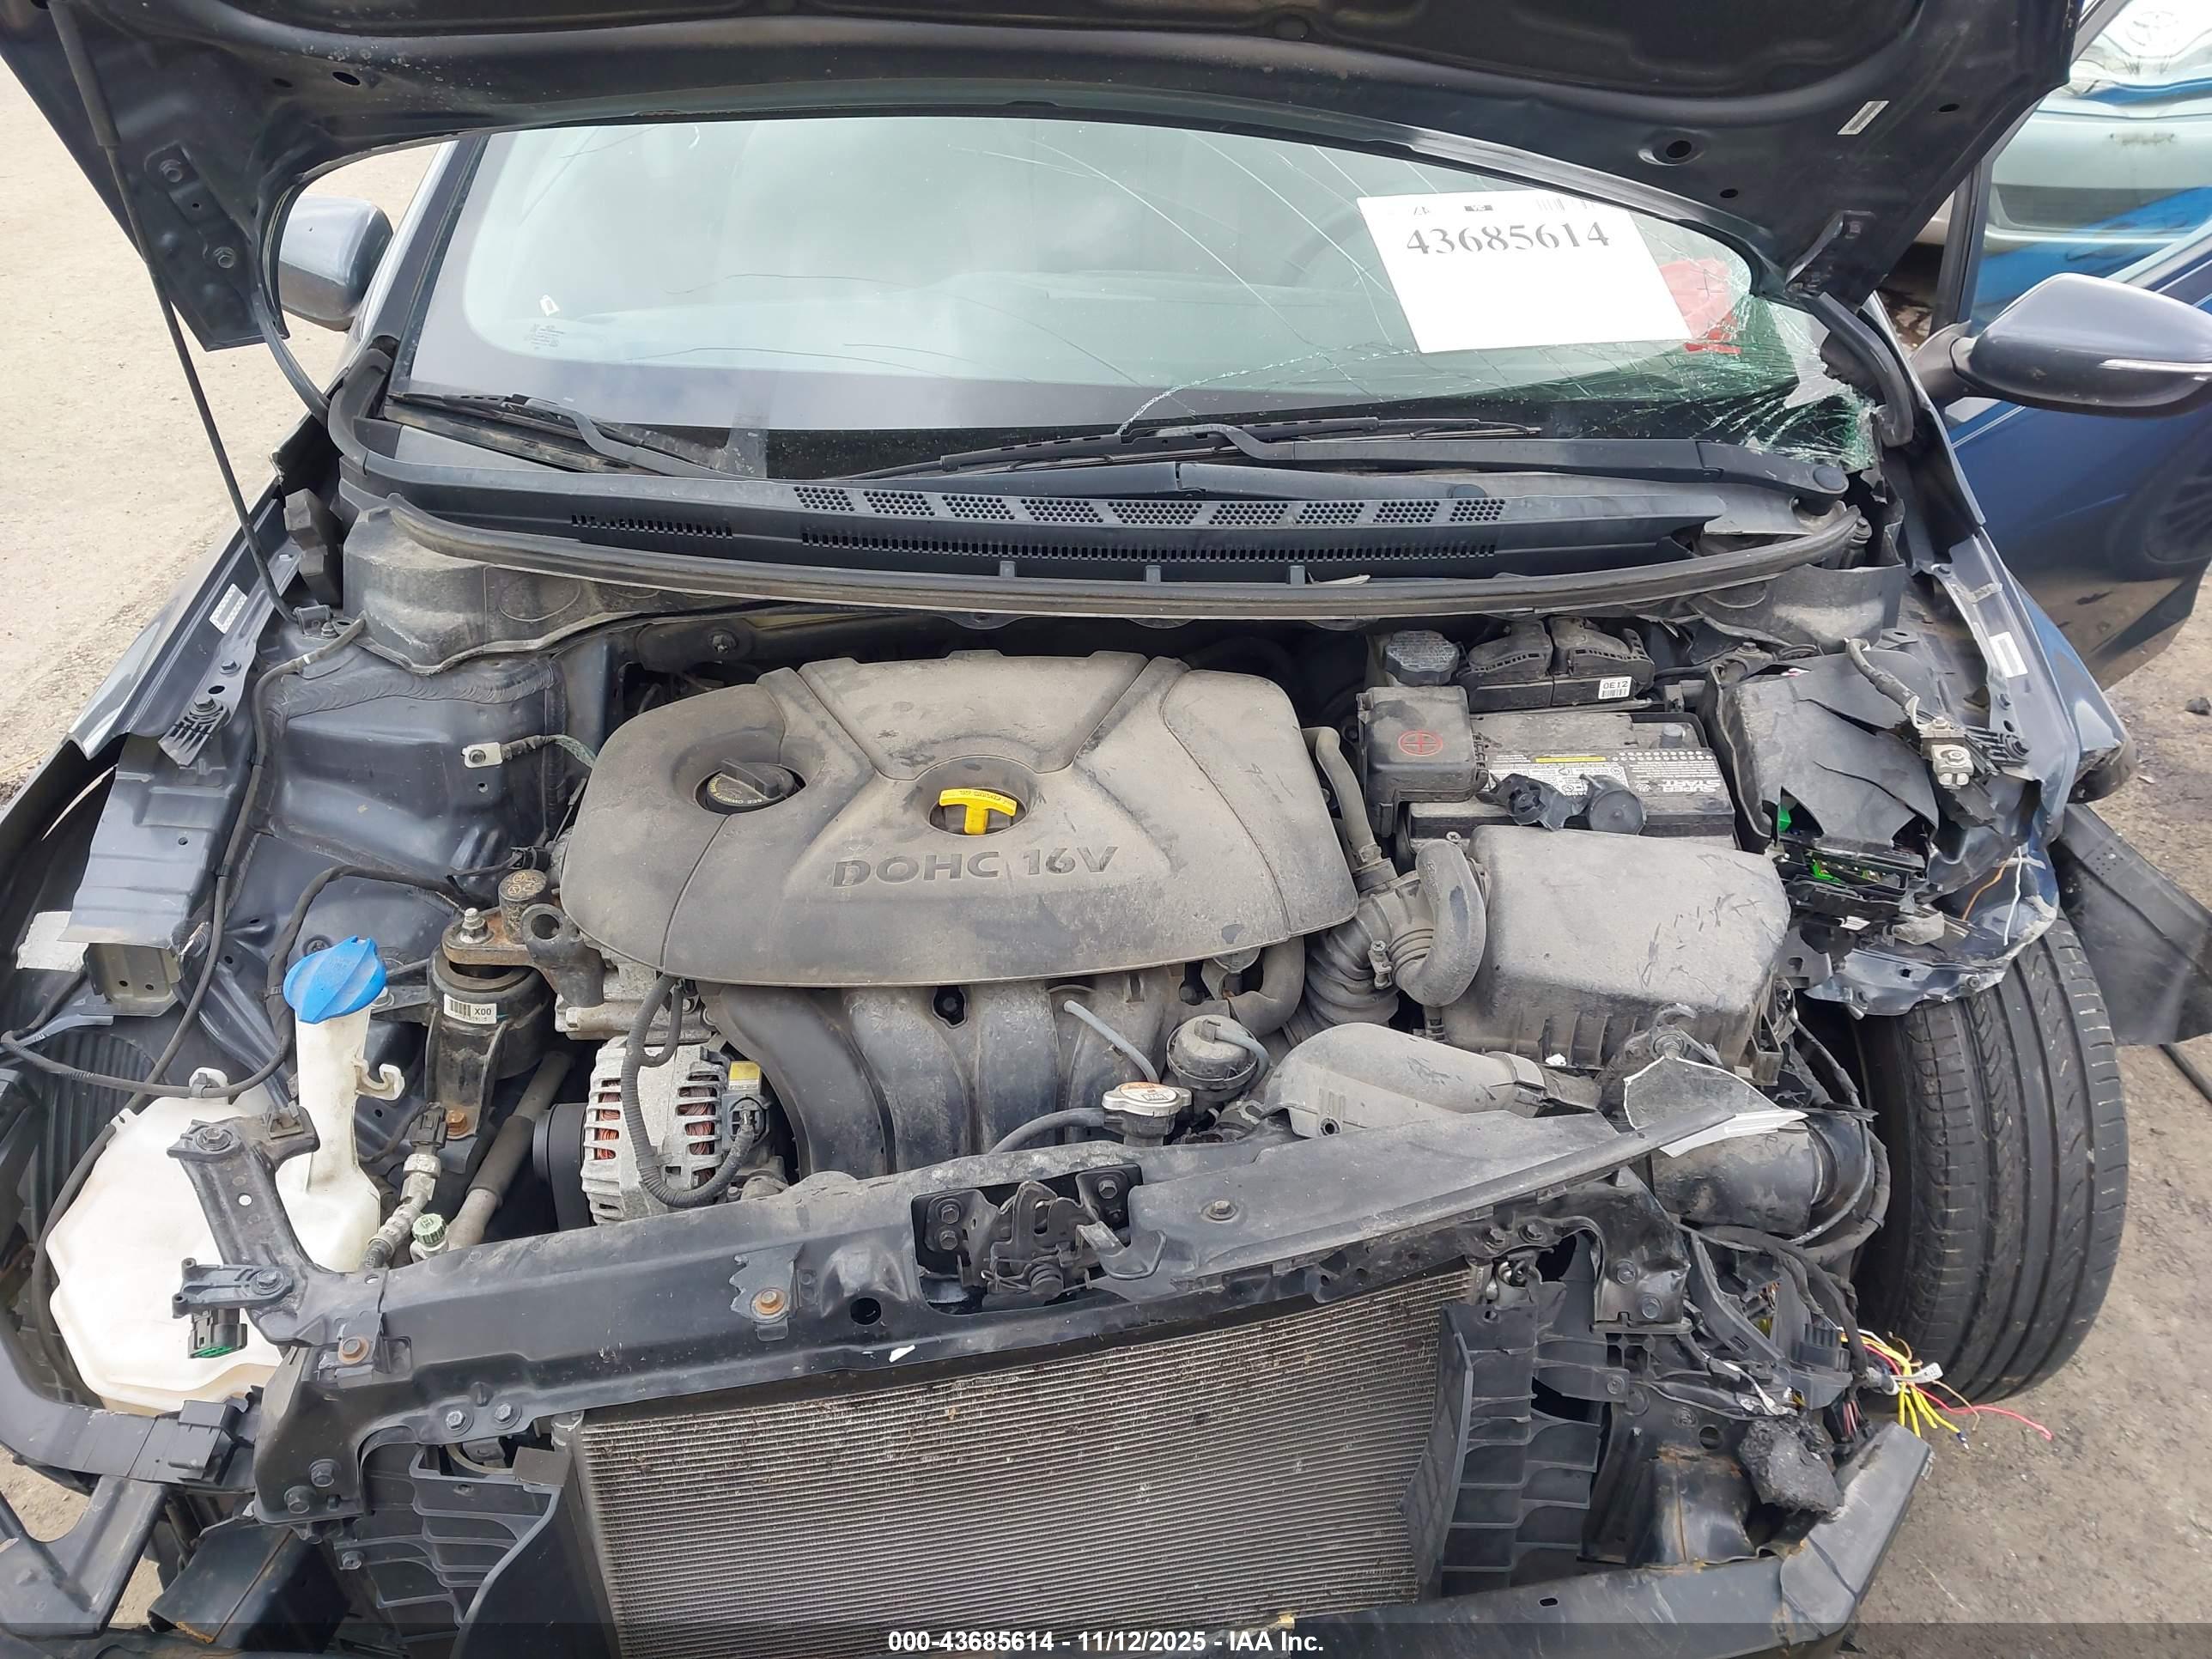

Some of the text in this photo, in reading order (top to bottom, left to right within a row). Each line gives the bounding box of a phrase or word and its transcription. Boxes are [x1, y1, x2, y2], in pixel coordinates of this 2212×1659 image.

[1407, 222, 1610, 254] 43685614
[831, 846, 1119, 887] DOHC 16V
